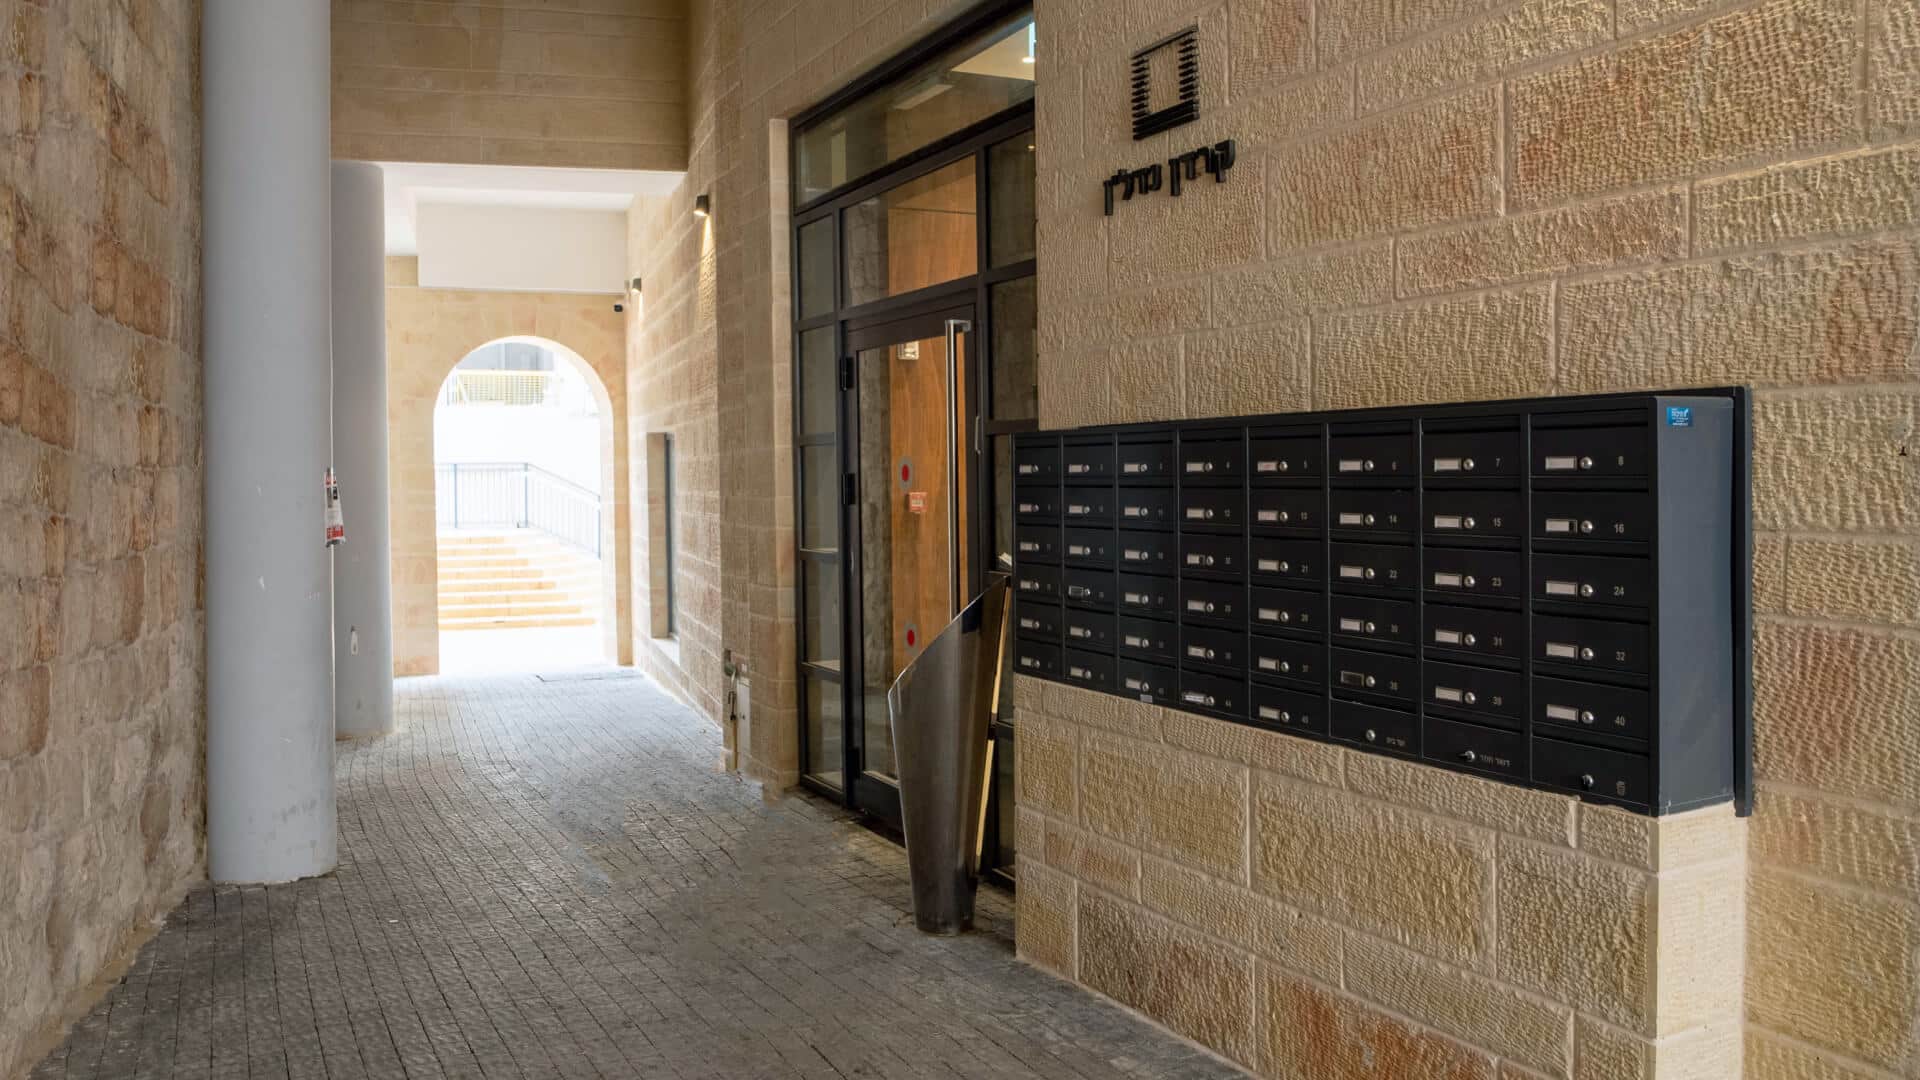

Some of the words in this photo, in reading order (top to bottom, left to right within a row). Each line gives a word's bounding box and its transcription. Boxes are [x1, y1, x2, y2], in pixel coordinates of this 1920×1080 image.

[1168, 139, 1236, 197] קרדן
[1613, 523, 1626, 534] 16
[1613, 585, 1625, 596] 24
[1615, 650, 1625, 661] 32
[1614, 715, 1626, 726] 40
